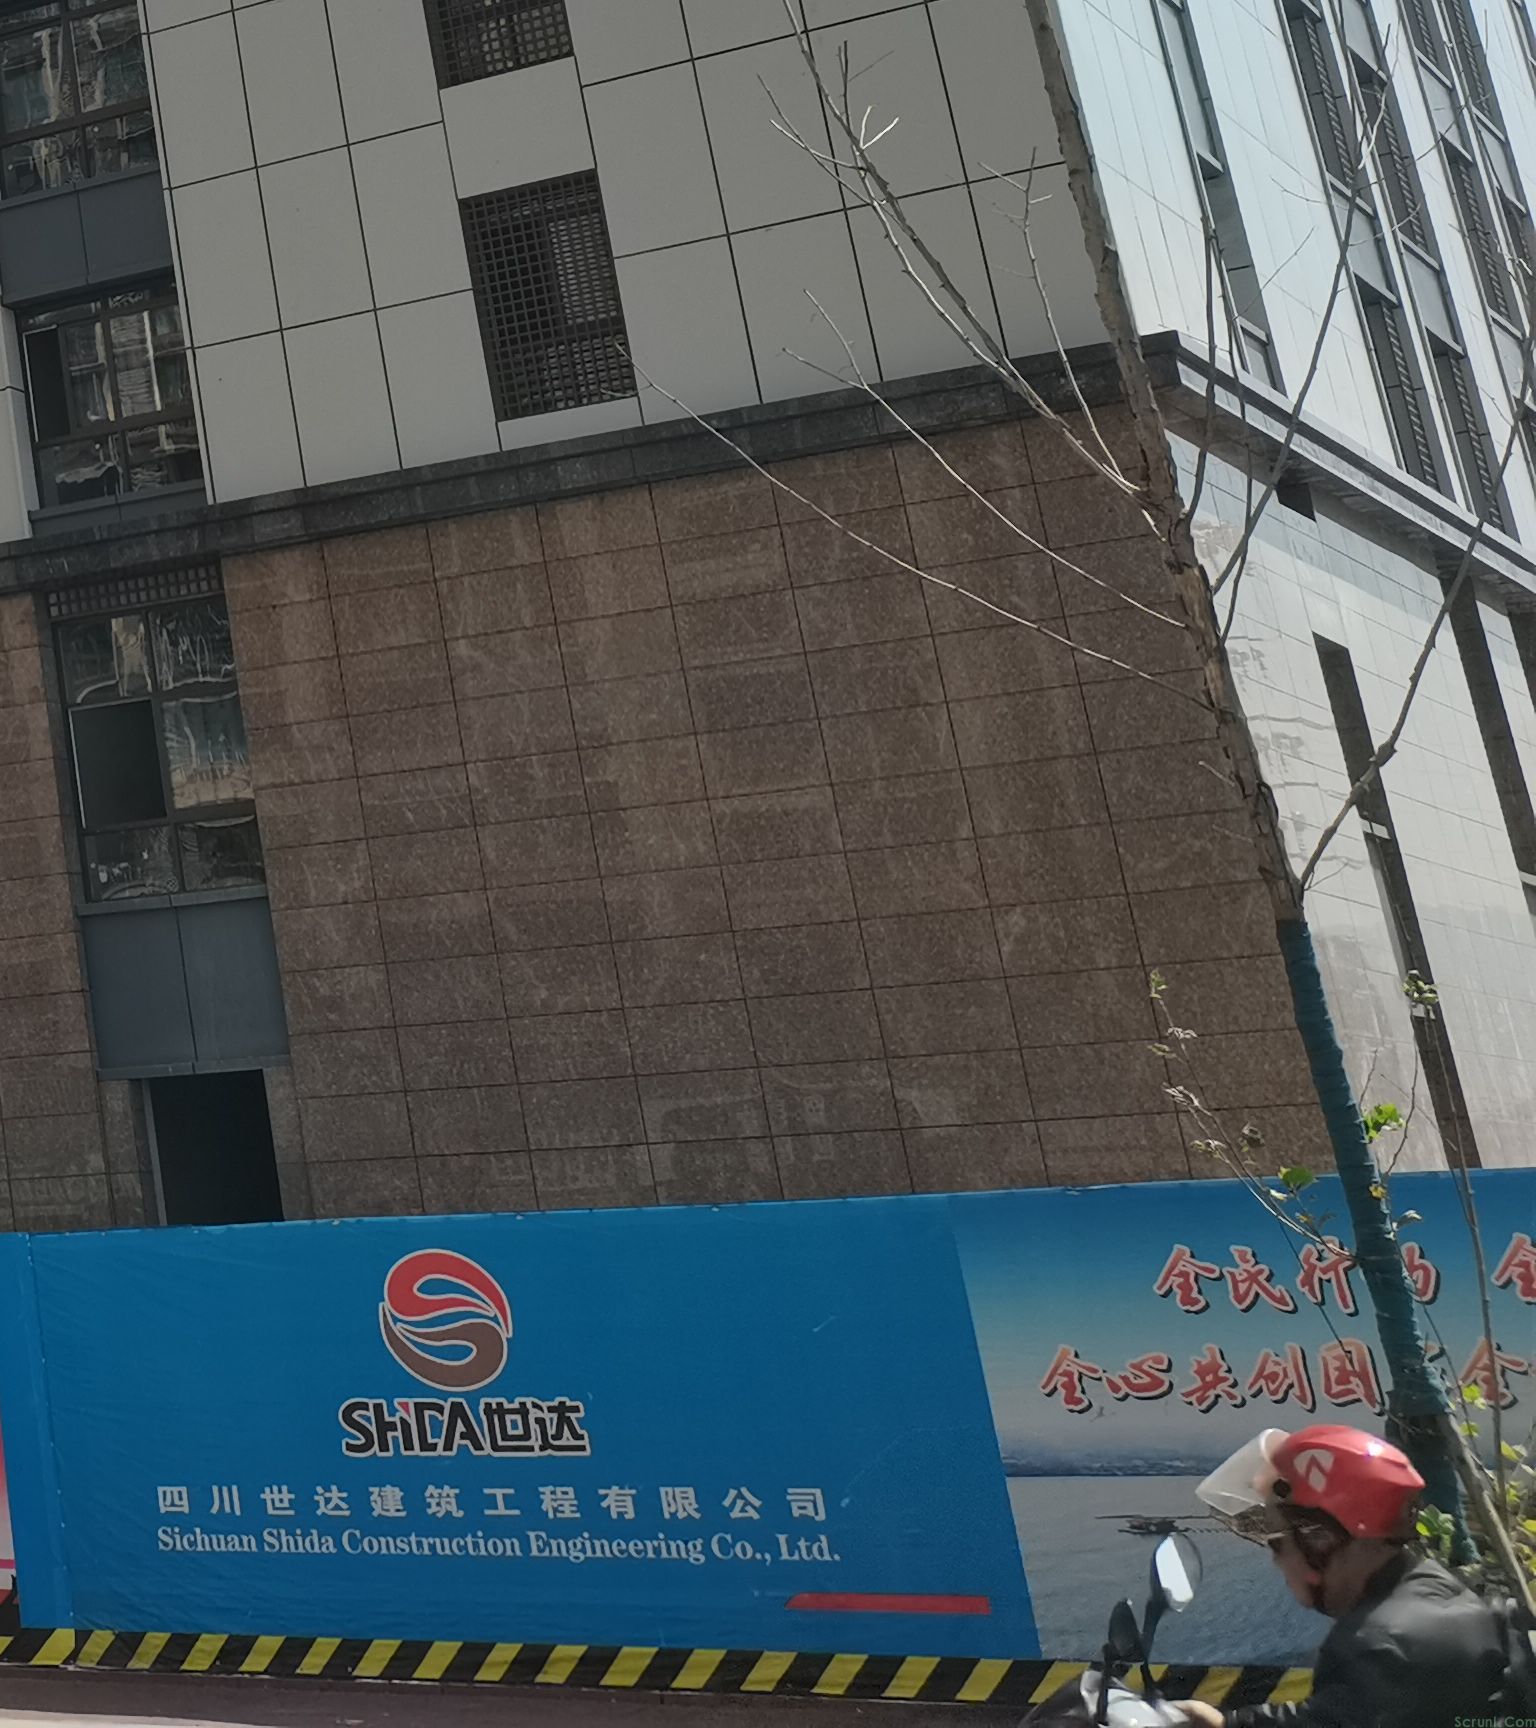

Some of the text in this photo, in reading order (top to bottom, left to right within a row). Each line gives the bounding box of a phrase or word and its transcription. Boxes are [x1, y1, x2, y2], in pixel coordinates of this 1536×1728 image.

[156, 1483, 827, 1522] 四川世达建筑工程有限公司
[157, 1526, 841, 1566] Sichuan Shida Construction Engineering Co., Ltd.
